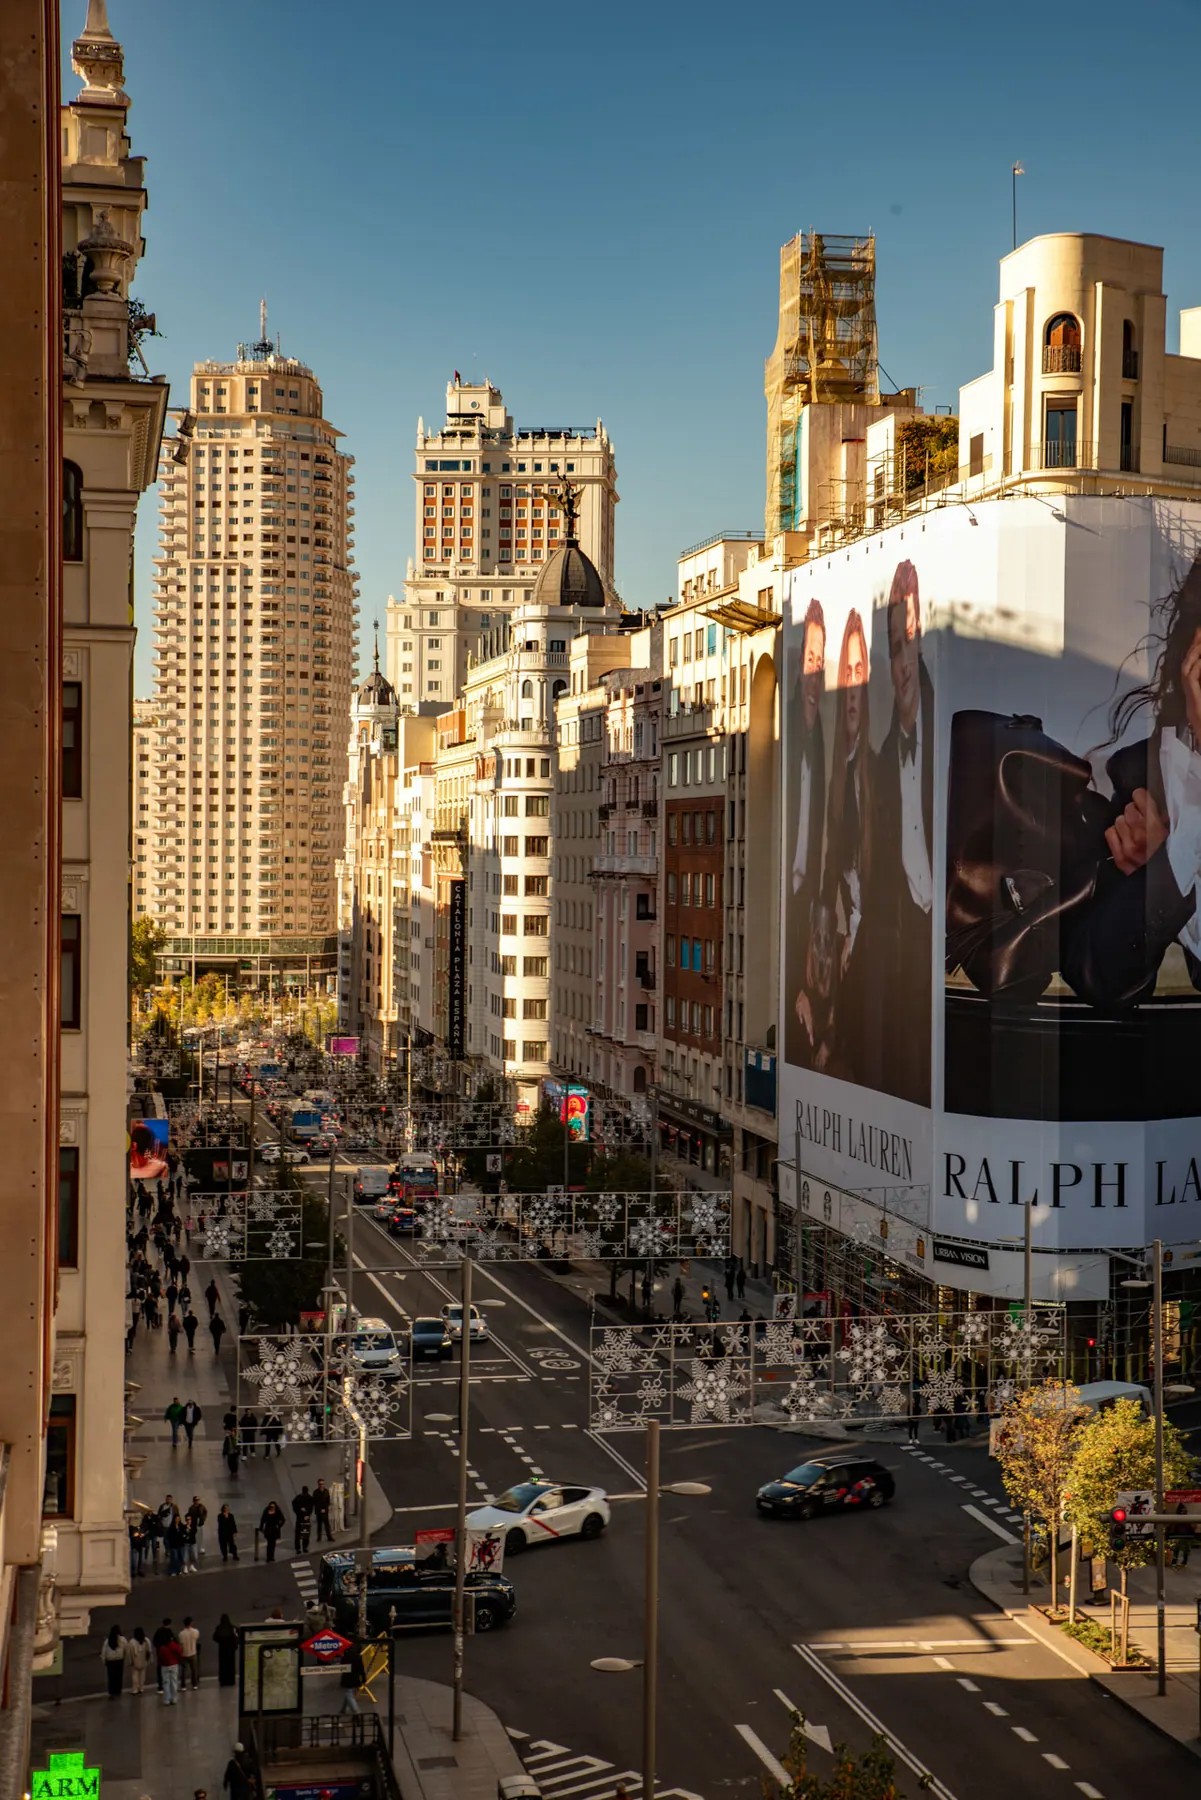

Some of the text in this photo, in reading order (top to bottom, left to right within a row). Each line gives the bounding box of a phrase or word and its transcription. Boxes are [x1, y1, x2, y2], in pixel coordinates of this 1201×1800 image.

[454, 885, 462, 952] CATALONIA
[453, 957, 461, 995] PLAZA
[796, 1099, 913, 1183] RALPH LAUREN
[943, 1152, 1129, 1208] RALPH
[960, 1252, 986, 1265] VISION
[314, 1641, 339, 1650] Metro
